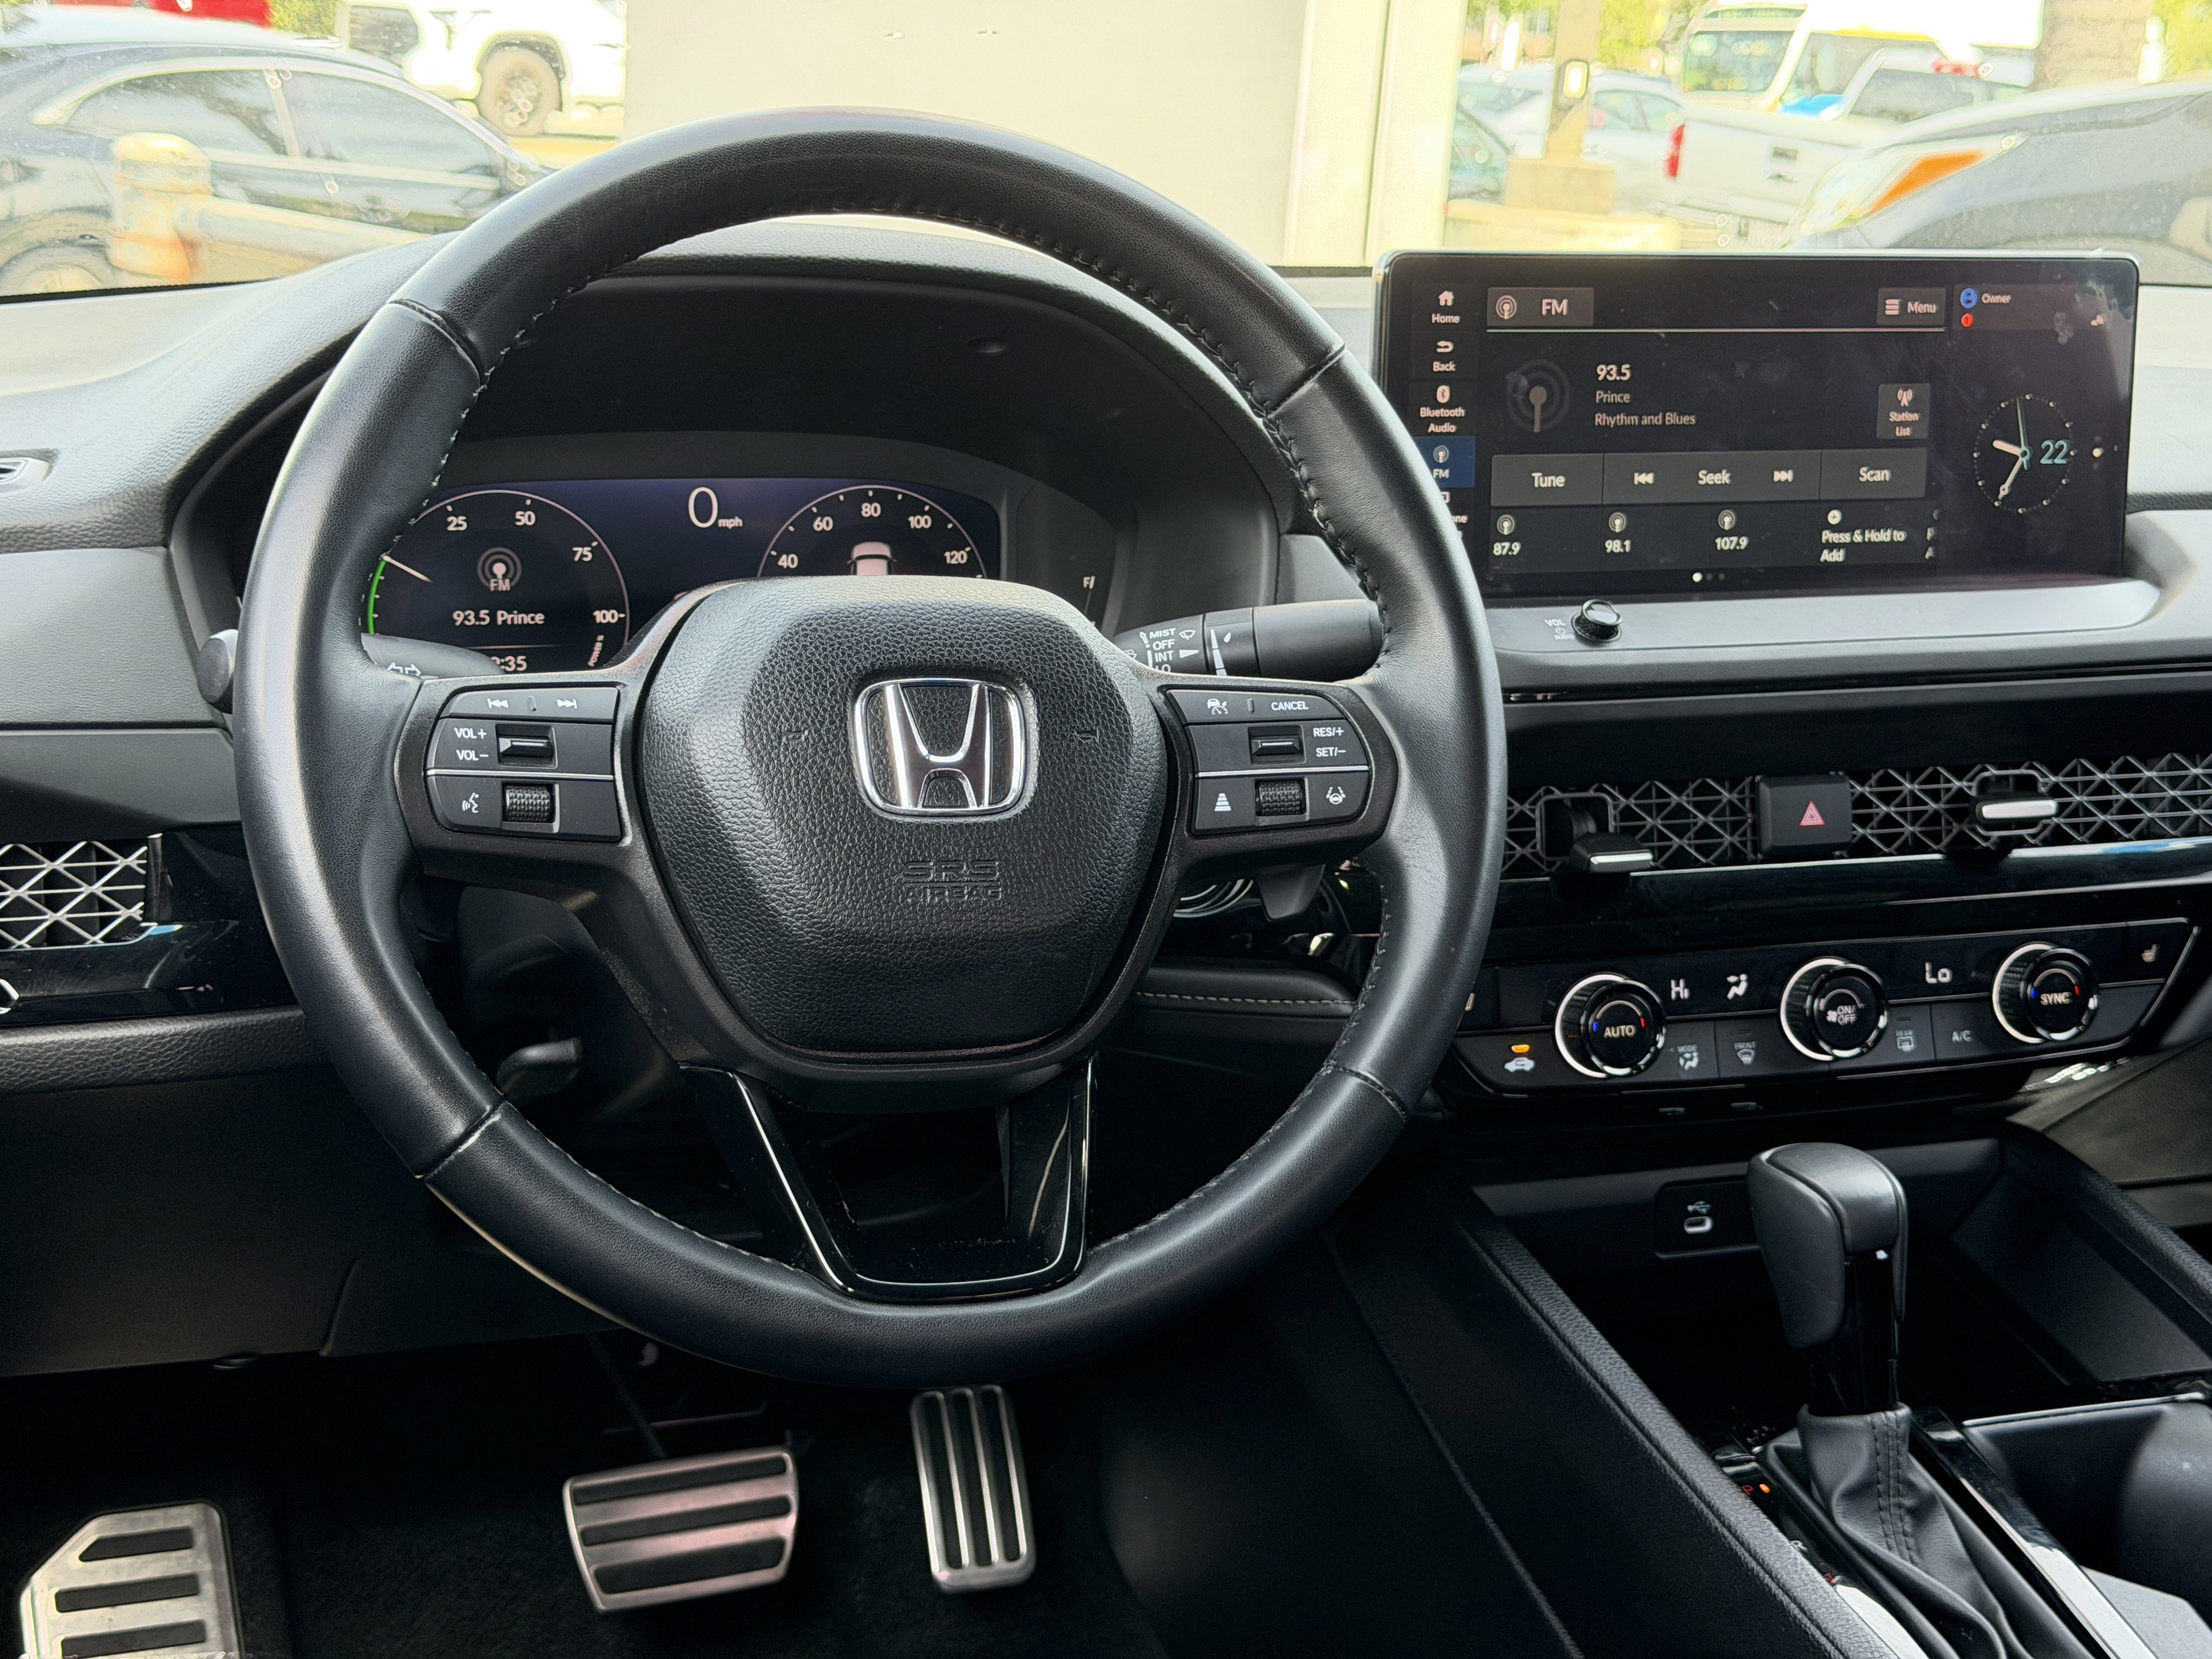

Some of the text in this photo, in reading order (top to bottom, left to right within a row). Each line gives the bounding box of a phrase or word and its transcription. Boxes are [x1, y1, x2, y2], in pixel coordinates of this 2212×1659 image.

[1982, 293, 2011, 303] Owner
[1542, 299, 1567, 315] FM
[1908, 301, 1937, 314] Menu
[1431, 314, 1460, 323] Home
[1433, 362, 1455, 371] Back
[1596, 365, 1630, 381] 93.5
[1596, 391, 1630, 403] Prince
[1420, 407, 1465, 417] Bluetooth
[1888, 411, 1919, 422] Station
[1595, 413, 1696, 427] Rhythm and Blues
[1427, 422, 1457, 432] Audio
[1895, 426, 1911, 436] List
[2040, 441, 2069, 464] 22
[1433, 470, 1449, 478] FM
[1532, 473, 1565, 487] Tune
[1698, 471, 1731, 484] Seek
[1859, 467, 1890, 481] Scan
[689, 487, 743, 529] 0 mph
[861, 503, 881, 517] 80
[447, 516, 467, 531] 25
[515, 511, 535, 526] 50
[813, 516, 833, 532] 60
[909, 515, 932, 529] 100
[1821, 528, 1905, 544] Press & Hold to
[1493, 542, 1521, 556] 87.9
[1605, 539, 1630, 553] 98.1
[1715, 537, 1748, 550] 107.9
[573, 548, 592, 562] 75
[778, 554, 798, 569] 40
[944, 550, 967, 565] 120
[1820, 549, 1845, 562] Add
[489, 579, 510, 591] FM
[453, 610, 545, 626] 93.5 Prince
[593, 611, 619, 623] 100
[1544, 618, 1566, 627] VOL
[1149, 628, 1177, 639] MIST
[1153, 639, 1175, 650] OFF
[1155, 651, 1173, 662] INT
[1271, 701, 1308, 710] CANCEL
[1313, 727, 1345, 737] RES/+
[905, 861, 999, 881] SRS
[905, 887, 1002, 902] AIRBAG
[1925, 962, 1953, 984] Lo
[2040, 992, 2073, 1006] SYNC
[1838, 1014, 1857, 1025] OFF
[1604, 1025, 1636, 1037] AUTO
[1951, 1030, 1974, 1042] A/C
